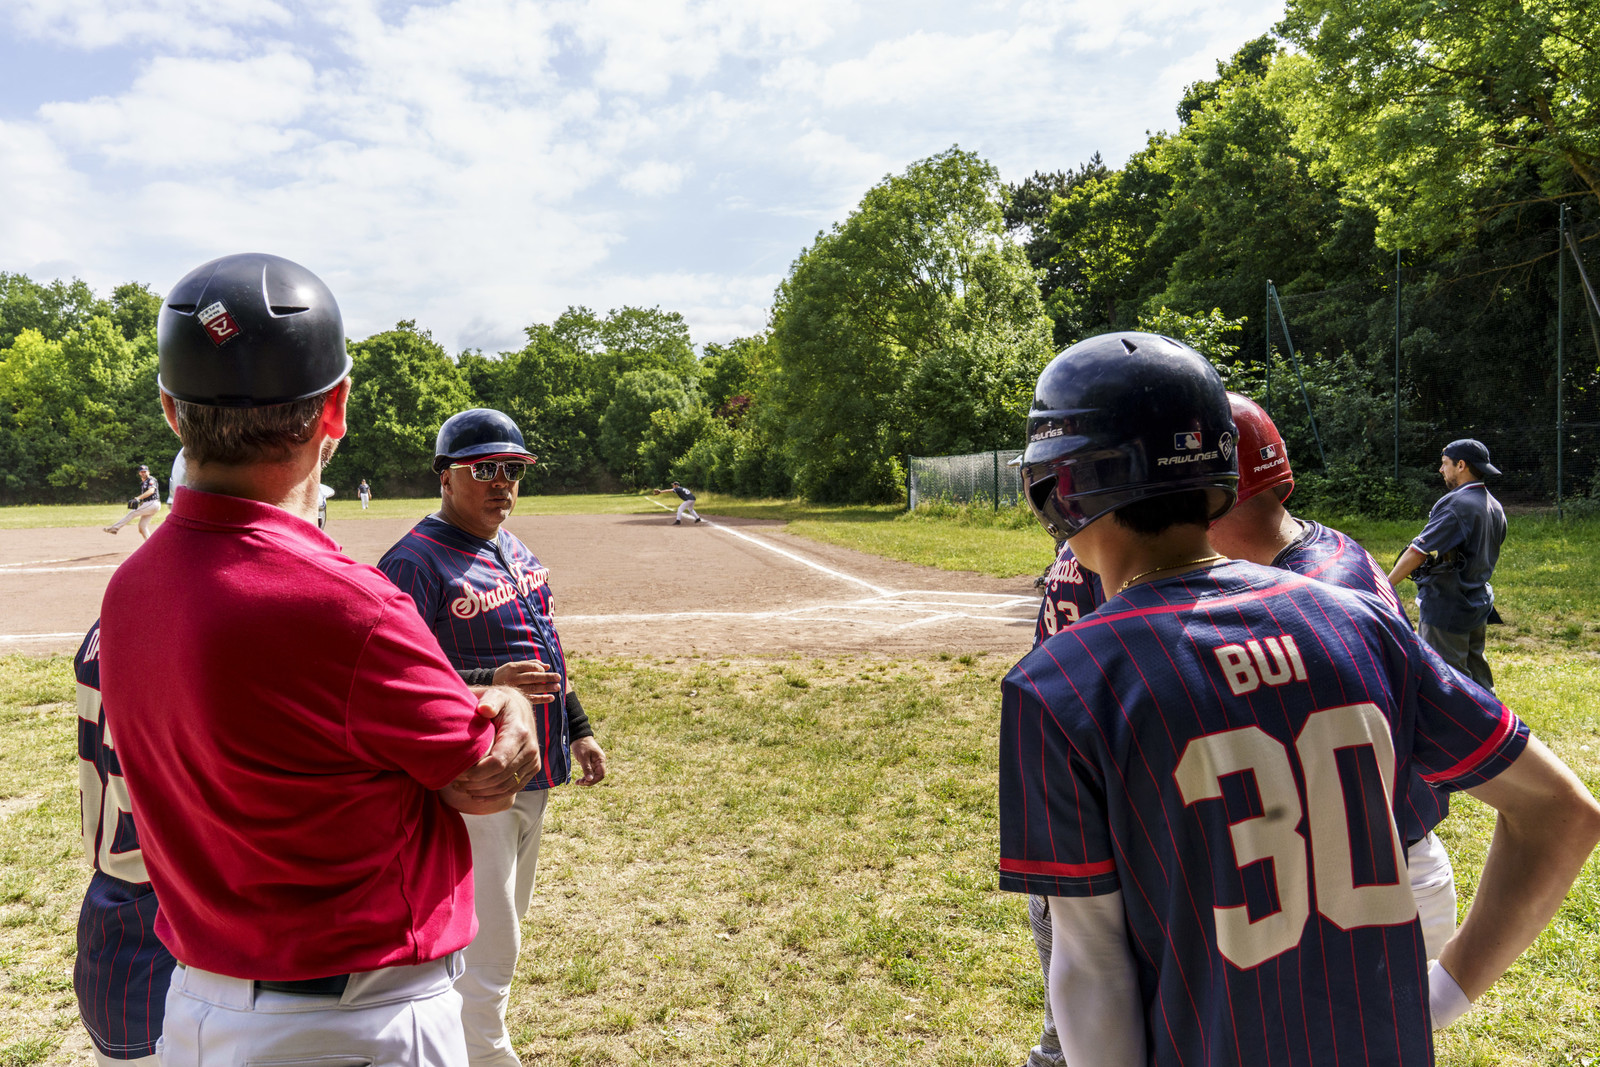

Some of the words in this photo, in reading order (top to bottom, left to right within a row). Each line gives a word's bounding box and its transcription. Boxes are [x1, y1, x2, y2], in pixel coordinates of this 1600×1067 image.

[1030, 427, 1064, 441] RAWLINGS
[1157, 450, 1219, 466] RAWLINGS
[1253, 456, 1285, 473] RAWLINGS
[451, 577, 518, 619] Stade
[508, 561, 550, 598] Fran
[1044, 595, 1081, 636] 83
[1212, 633, 1309, 697] BUI
[1172, 701, 1418, 972] 30
